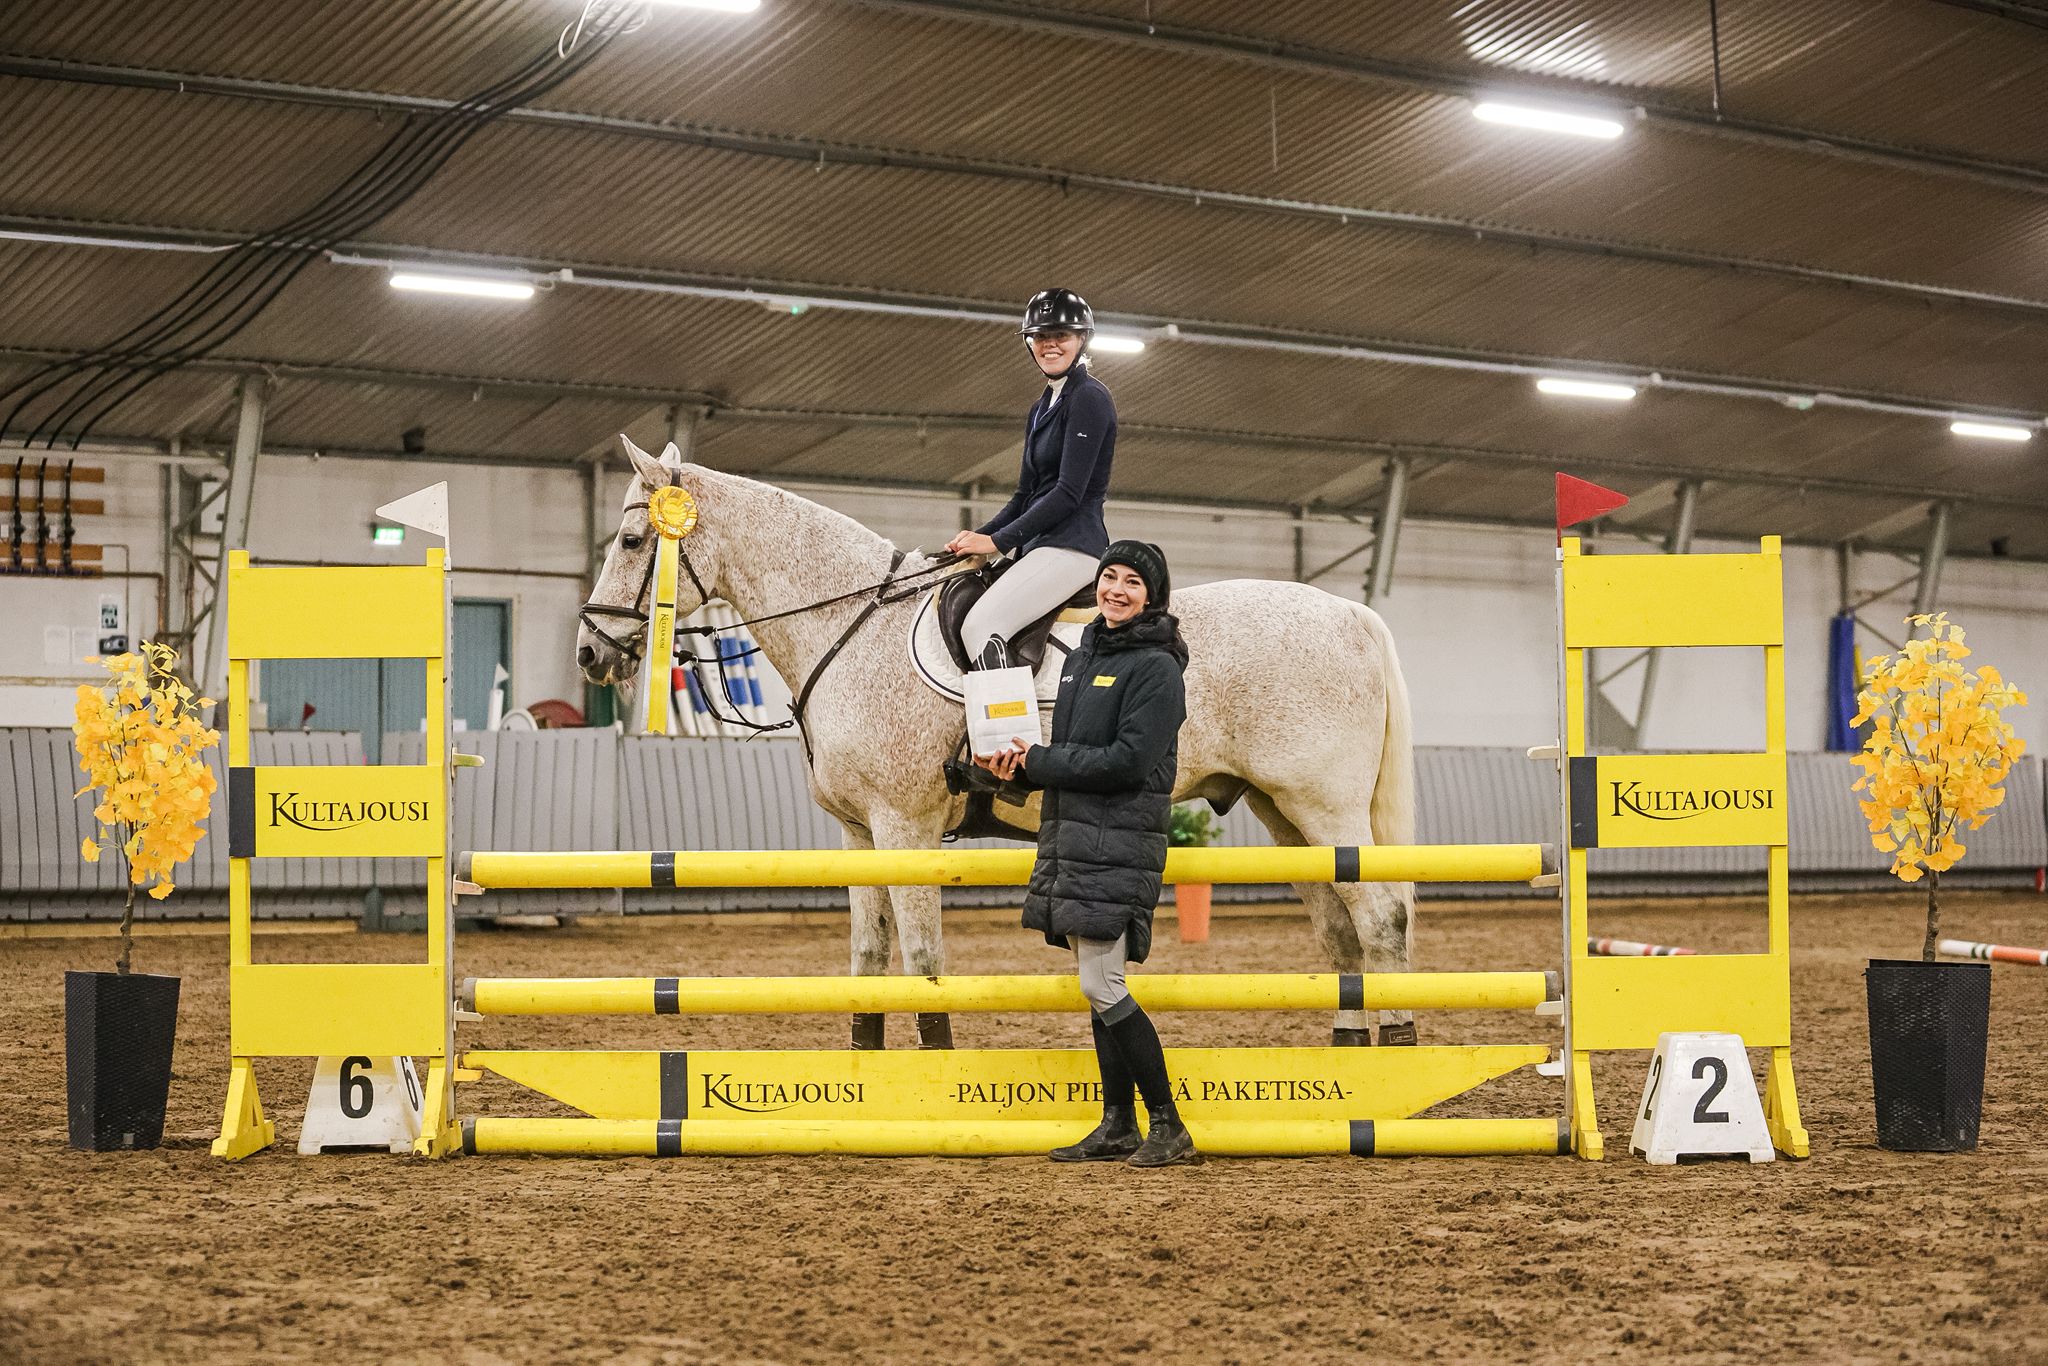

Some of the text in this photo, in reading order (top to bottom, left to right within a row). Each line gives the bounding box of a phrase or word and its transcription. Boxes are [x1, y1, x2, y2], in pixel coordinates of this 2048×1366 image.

[269, 792, 429, 831] KULTAJOUSI
[1611, 781, 1773, 821] KULTAJOUSI
[339, 1055, 374, 1119] 6
[702, 1074, 865, 1113] KULTAJOUSI
[949, 1082, 1057, 1109] -PALJON
[1201, 1080, 1354, 1102] PAKETISSA-
[1643, 1054, 1663, 1121] 2
[1691, 1056, 1730, 1124] 2
